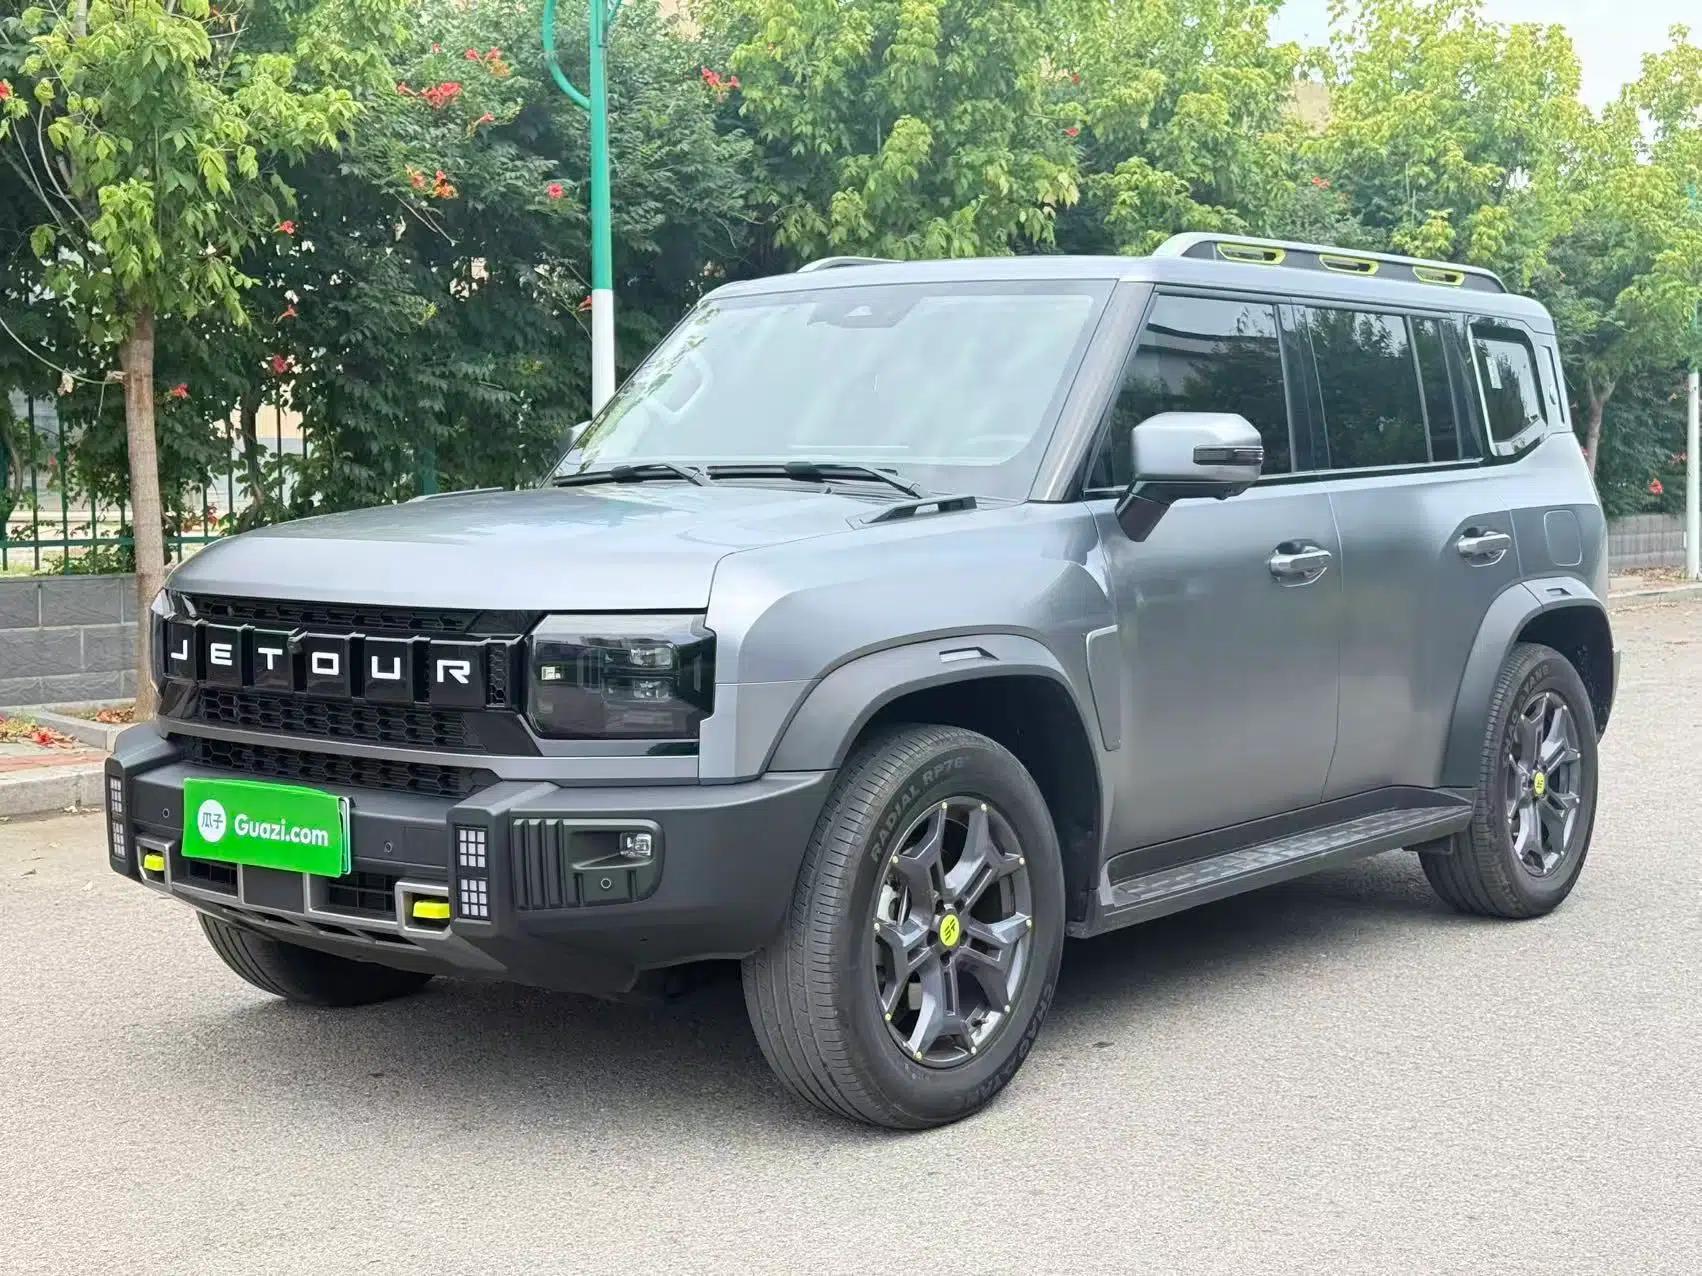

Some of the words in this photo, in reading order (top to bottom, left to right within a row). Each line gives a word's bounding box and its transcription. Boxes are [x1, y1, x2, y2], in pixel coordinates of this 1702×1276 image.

[170, 639, 470, 684] JETOUR
[200, 811, 224, 830] 瓜子
[234, 813, 329, 847] Guazi.com
[870, 785, 920, 863] RADIAL
